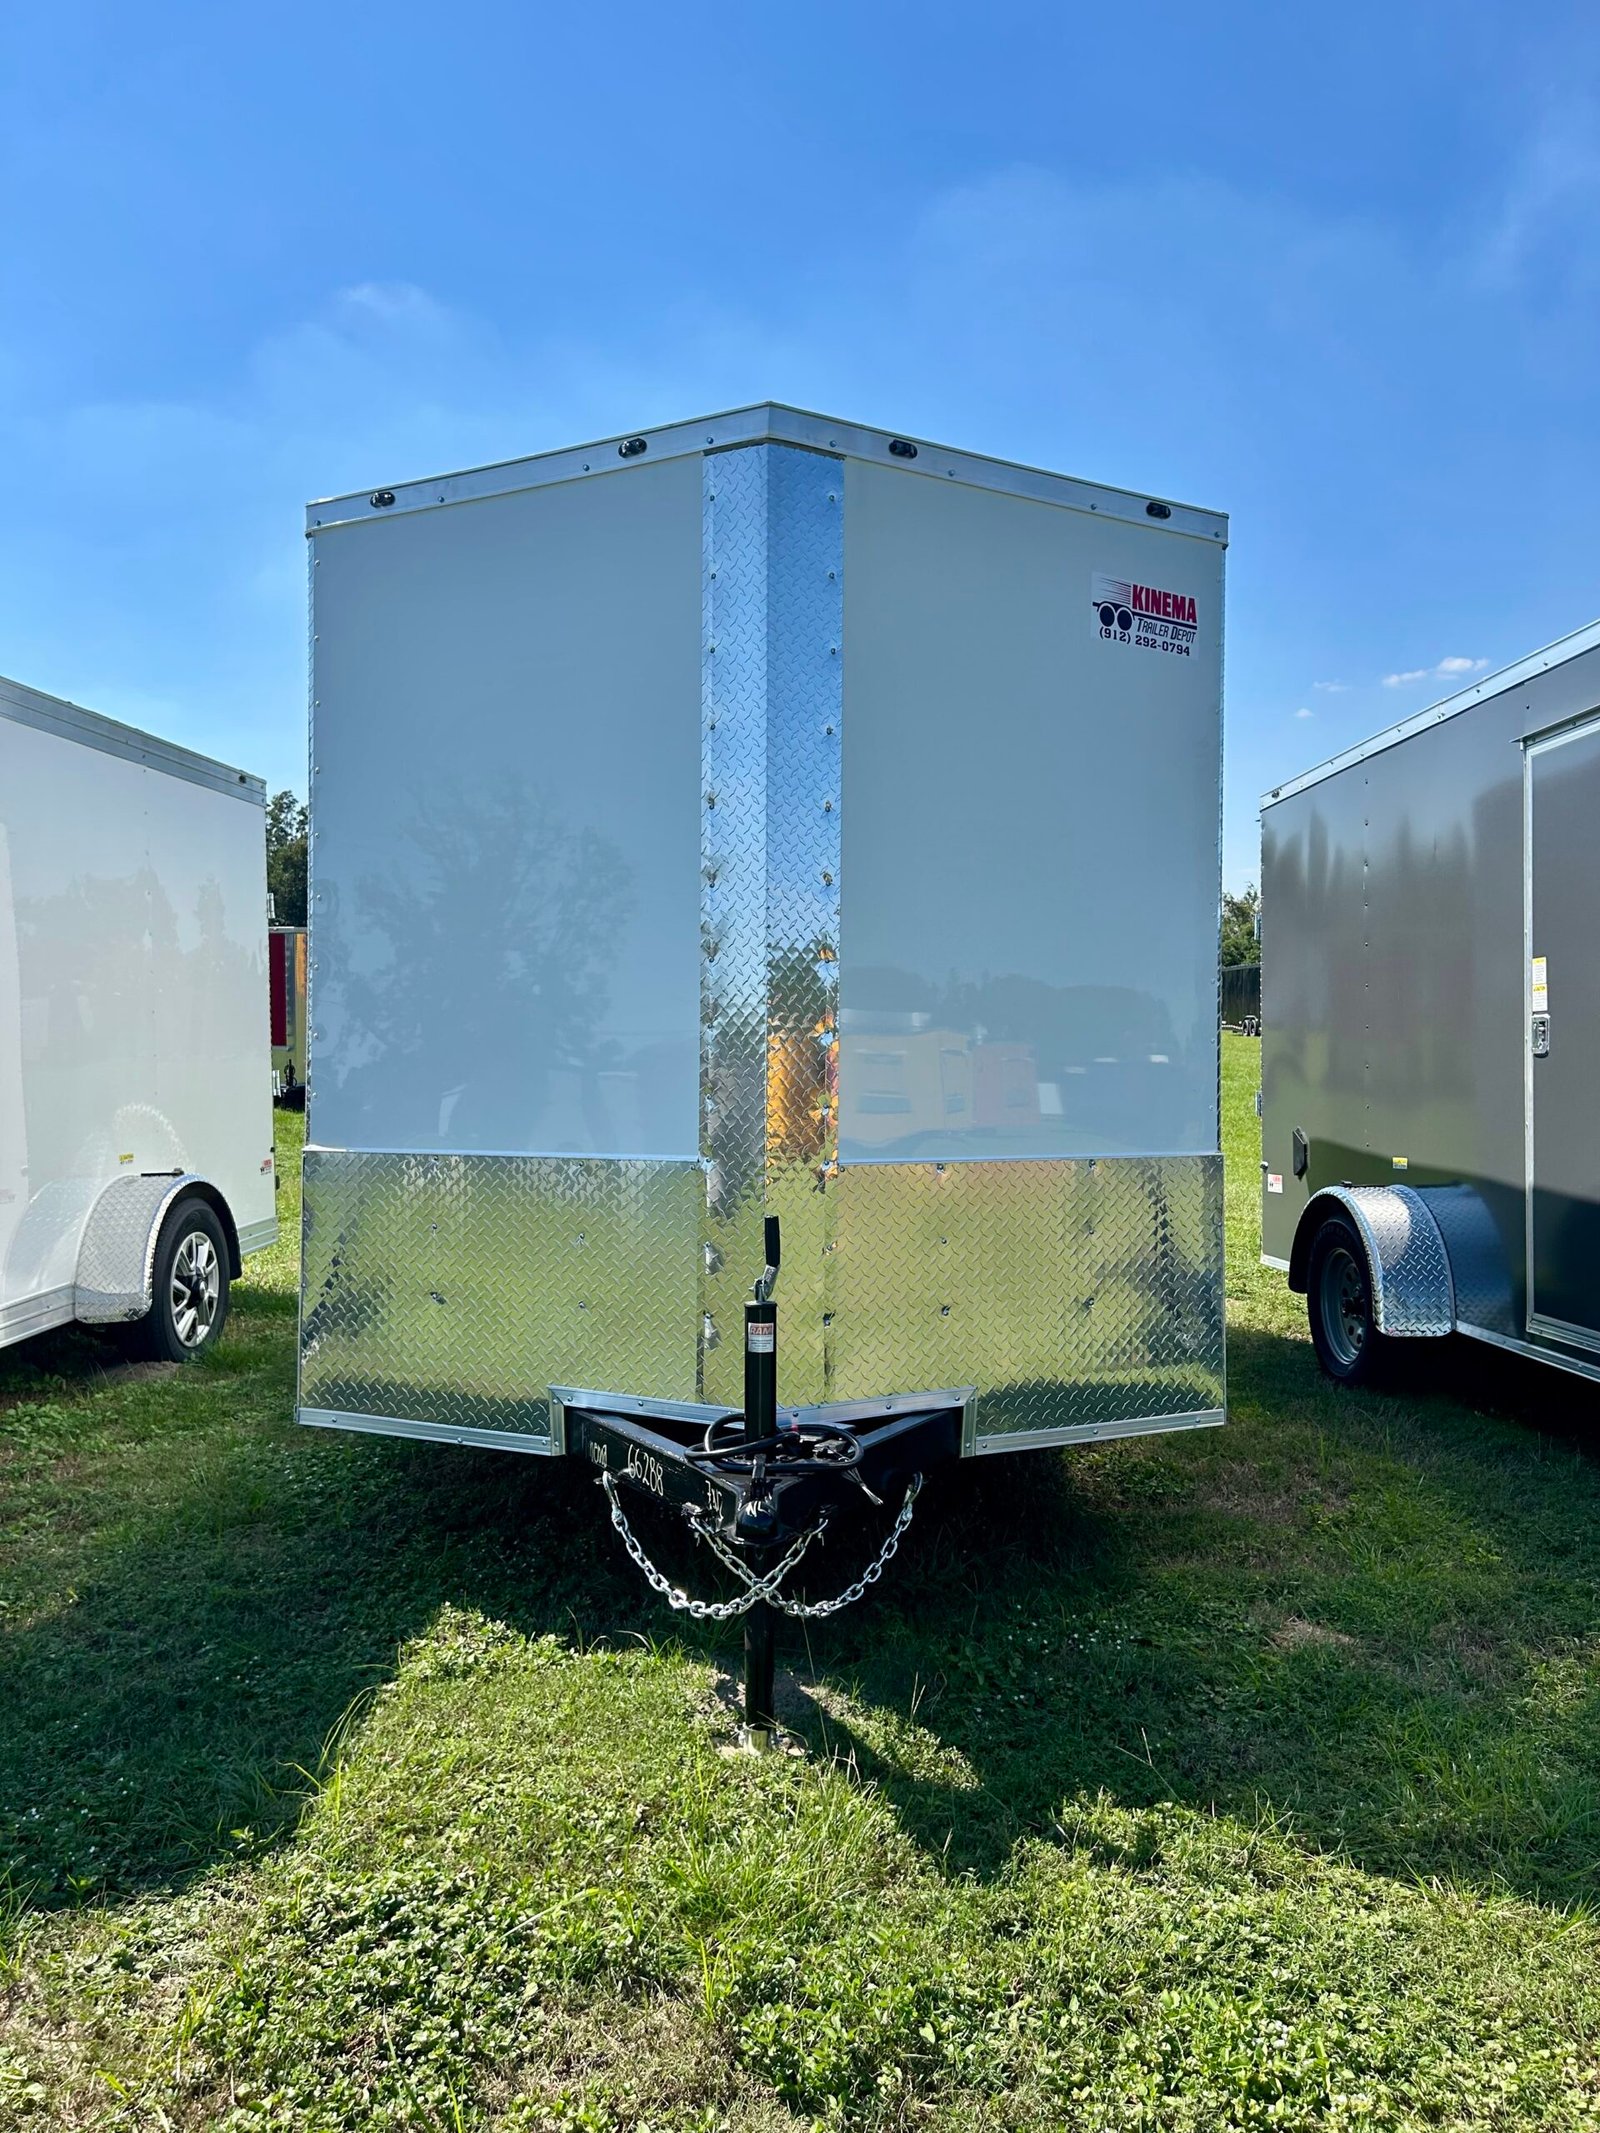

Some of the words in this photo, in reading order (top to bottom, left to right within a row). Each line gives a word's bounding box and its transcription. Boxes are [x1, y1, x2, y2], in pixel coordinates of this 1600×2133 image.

[1132, 583, 1197, 623] KINEMA
[1099, 626, 1131, 645] (912)
[1135, 634, 1190, 656] 292-0794
[627, 1444, 664, 1496] 66288
